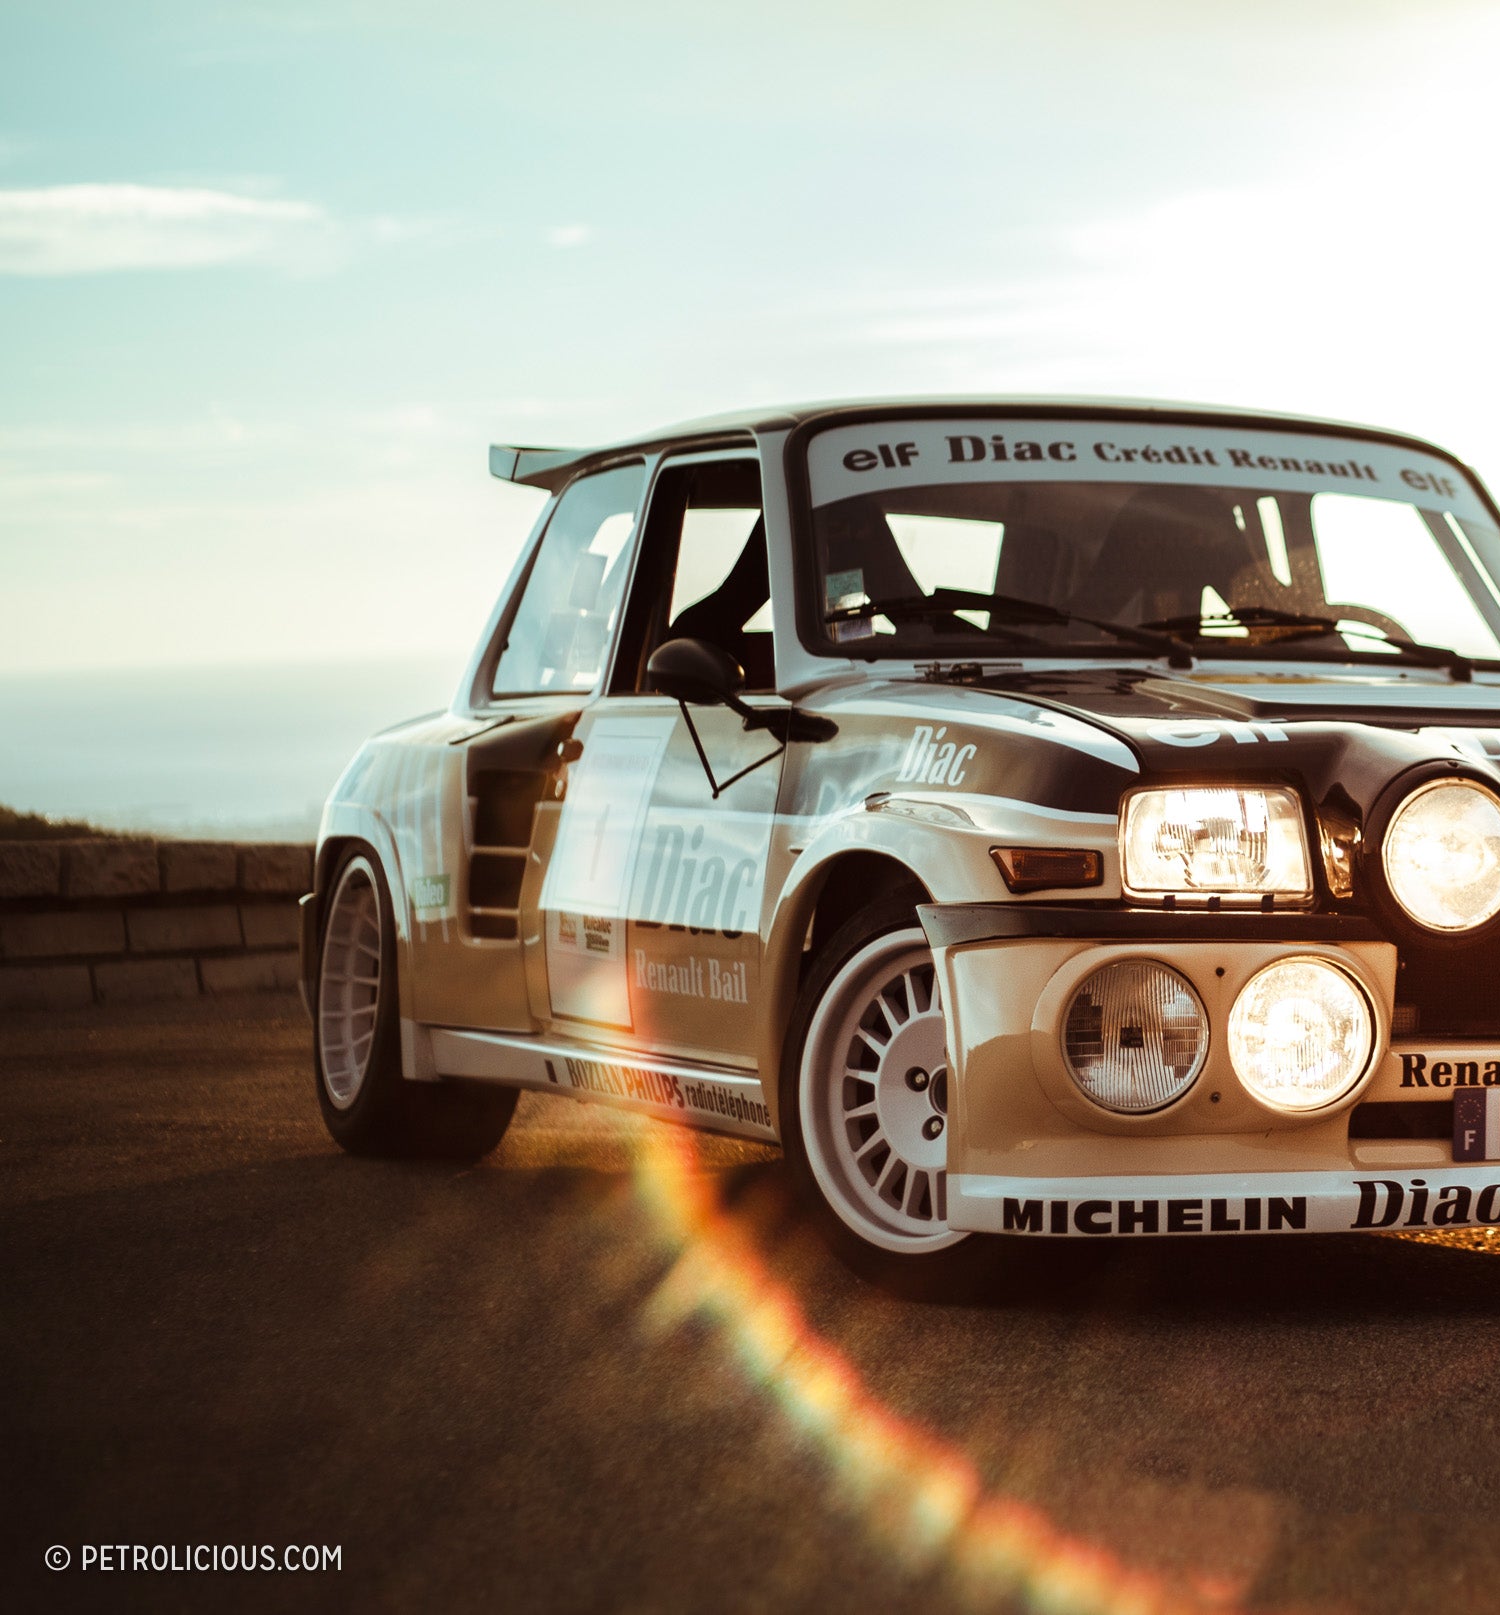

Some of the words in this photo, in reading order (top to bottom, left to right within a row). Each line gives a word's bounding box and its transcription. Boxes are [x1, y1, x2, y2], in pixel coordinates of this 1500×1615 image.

[843, 442, 919, 472] elf
[945, 435, 1076, 464] Diac
[1093, 442, 1219, 467] Crédit
[1225, 448, 1379, 482] Renault
[1399, 468, 1457, 499] elf
[896, 725, 978, 787] Diac
[635, 824, 757, 939] Diac
[633, 949, 705, 998] Renault
[709, 958, 749, 1004] Bail
[621, 1066, 685, 1109] PHILIPS
[1464, 1130, 1476, 1150] F
[1002, 1198, 1307, 1232] MICHELIN
